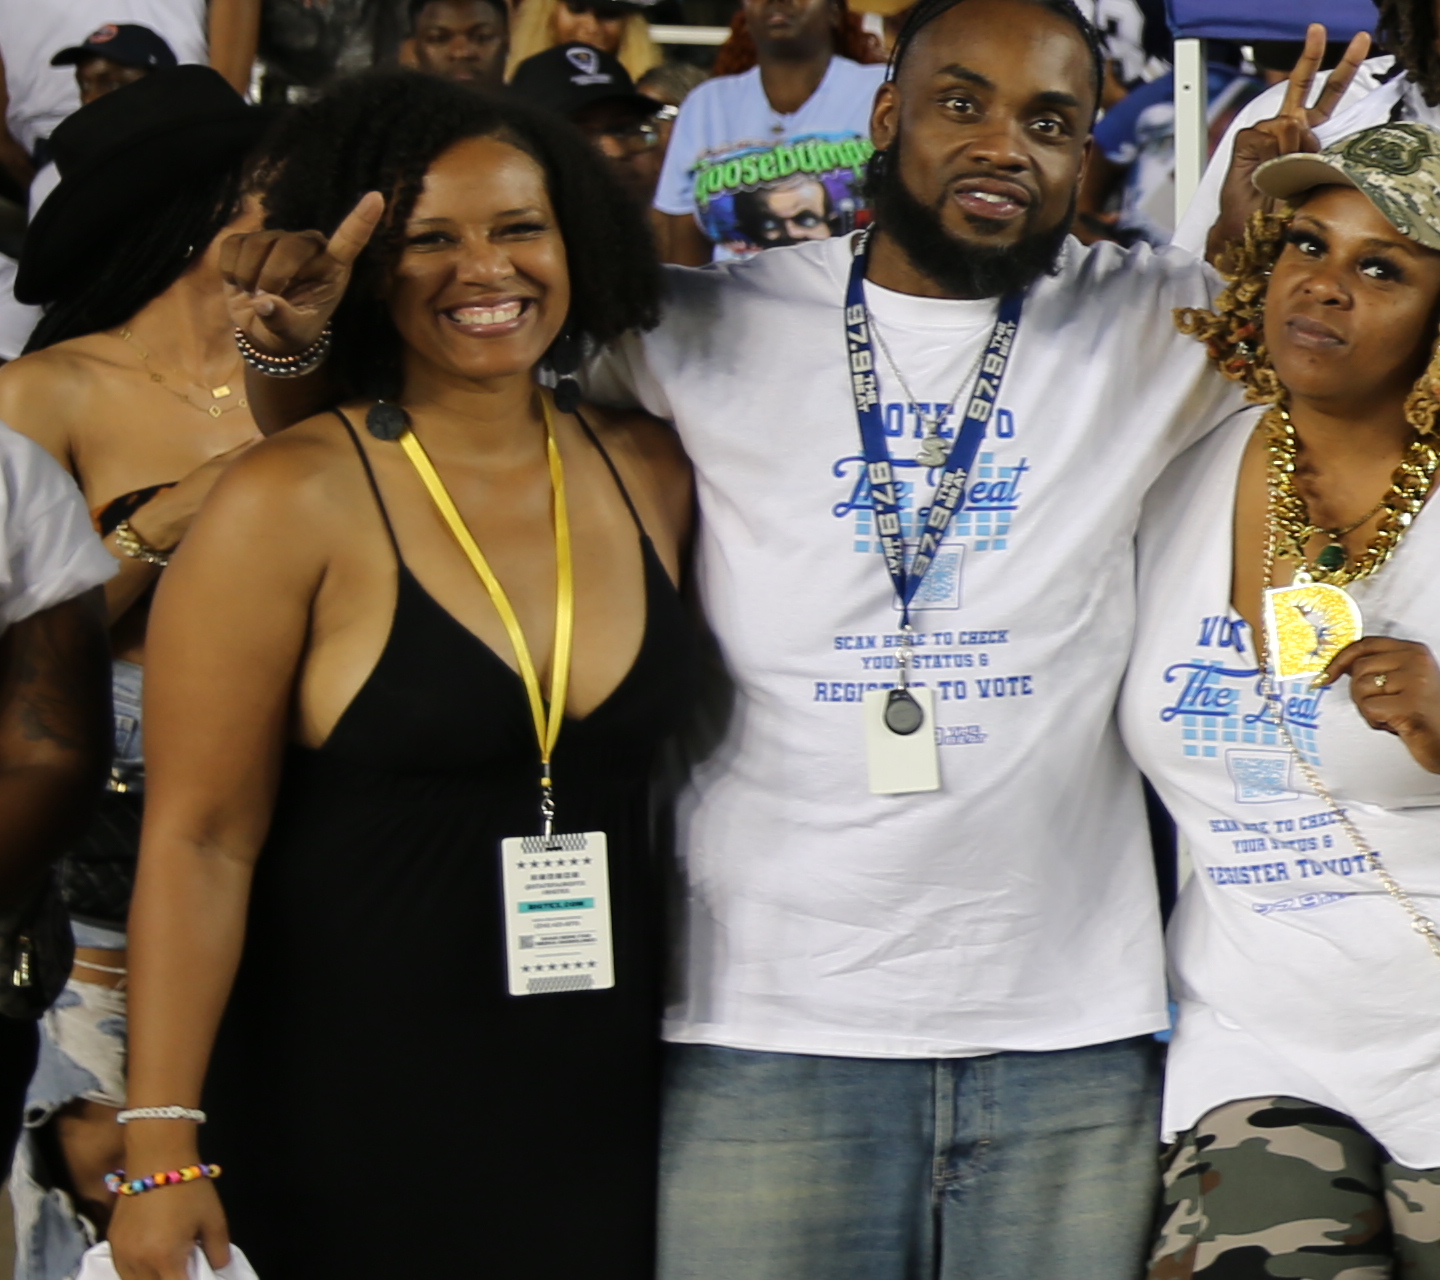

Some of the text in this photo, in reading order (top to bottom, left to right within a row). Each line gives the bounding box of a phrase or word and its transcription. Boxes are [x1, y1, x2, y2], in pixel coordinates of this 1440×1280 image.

[966, 352, 1006, 423] 97.9
[884, 401, 955, 439] OTE
[933, 632, 953, 647] TO
[911, 653, 965, 670] STATUS
[937, 680, 967, 700] TO
[975, 675, 1033, 699] VOTE
[1161, 662, 1248, 723] The
